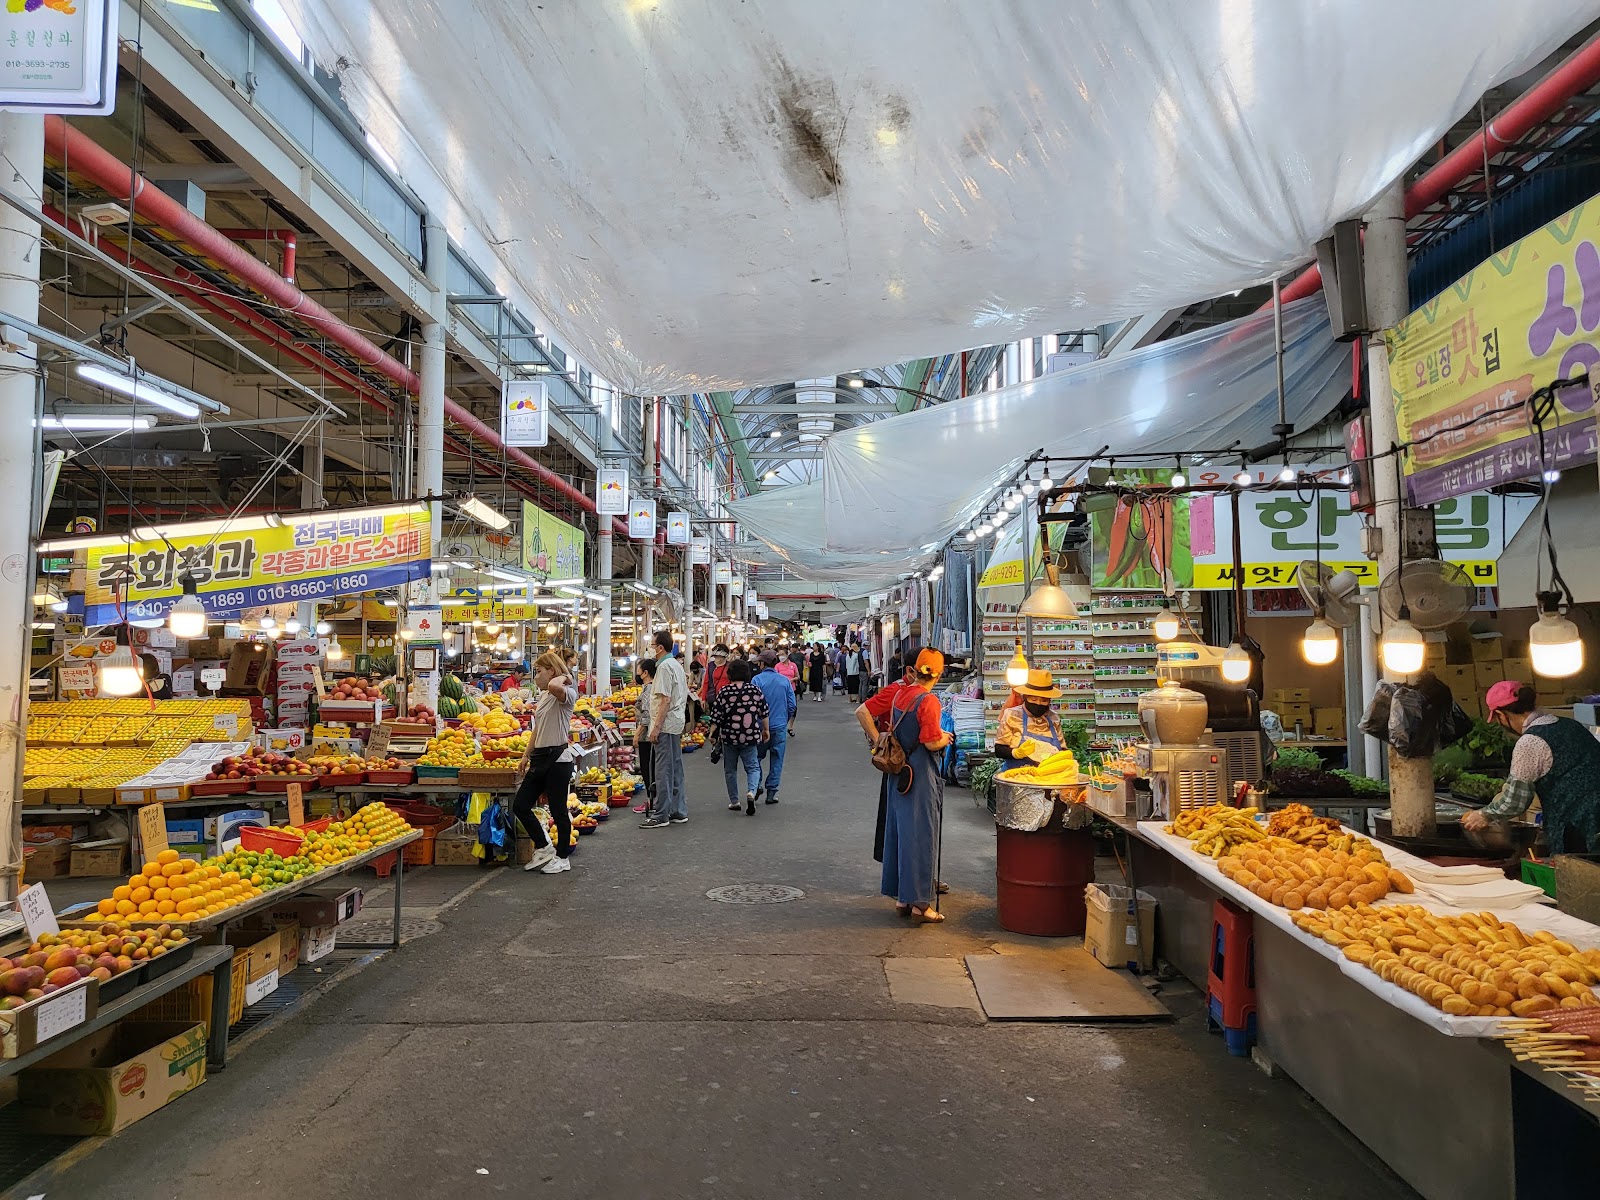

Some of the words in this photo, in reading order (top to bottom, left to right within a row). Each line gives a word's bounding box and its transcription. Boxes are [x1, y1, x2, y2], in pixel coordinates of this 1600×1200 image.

[1415, 344, 1452, 388] 오일장
[1452, 307, 1500, 386] 맛집
[295, 516, 383, 546] 전국택배
[257, 574, 369, 602] 010-8660-1860
